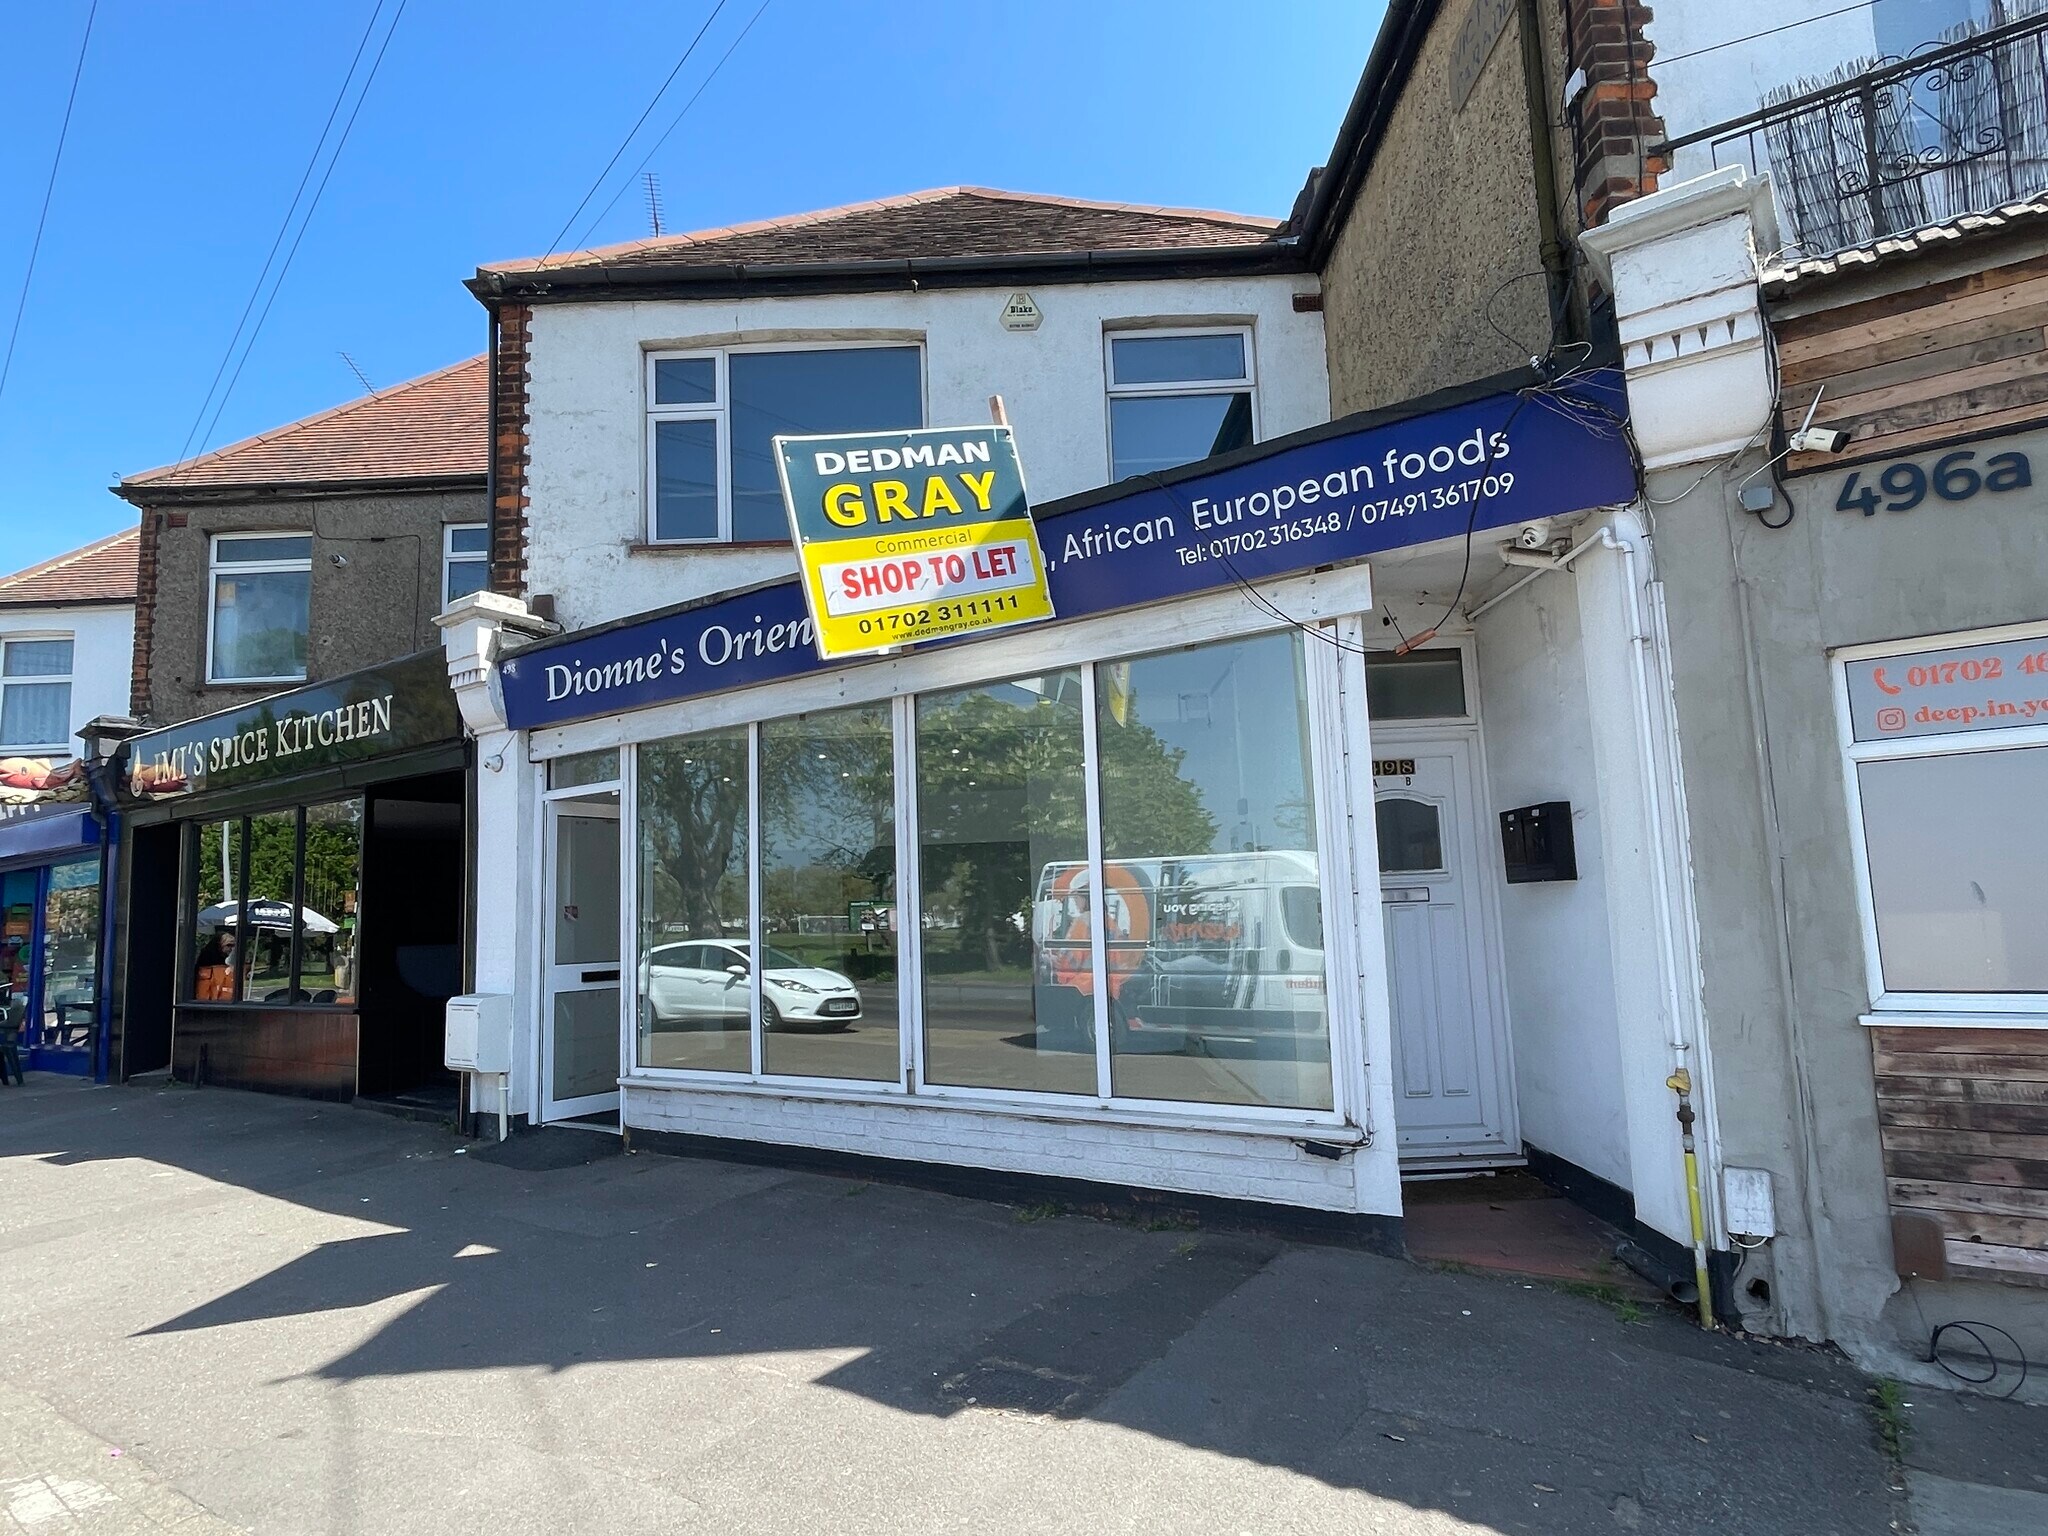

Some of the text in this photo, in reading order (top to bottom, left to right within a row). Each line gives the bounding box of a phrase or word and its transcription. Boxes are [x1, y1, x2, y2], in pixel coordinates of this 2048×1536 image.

[1010, 305, 1033, 313] Blake
[814, 441, 991, 476] DEDMAN
[822, 471, 996, 528] GRAY
[1063, 427, 1511, 564] African European foods
[1836, 451, 2032, 517] 496a
[1176, 472, 1515, 566] Tel: 01702 316348 / 07491 361709
[876, 529, 972, 554] Commercial
[841, 560, 922, 600] SHOP
[929, 554, 966, 585] TO
[972, 546, 1016, 580] LET
[859, 595, 1019, 634] 01702 311111
[892, 617, 993, 640] www.dedmangray.co.uk
[503, 663, 516, 674] 498
[545, 638, 685, 702] Dionne's
[1907, 657, 2003, 687] 01702
[210, 727, 269, 773] SPICE
[275, 695, 394, 757] KITCHEN
[1405, 776, 1412, 786] B
